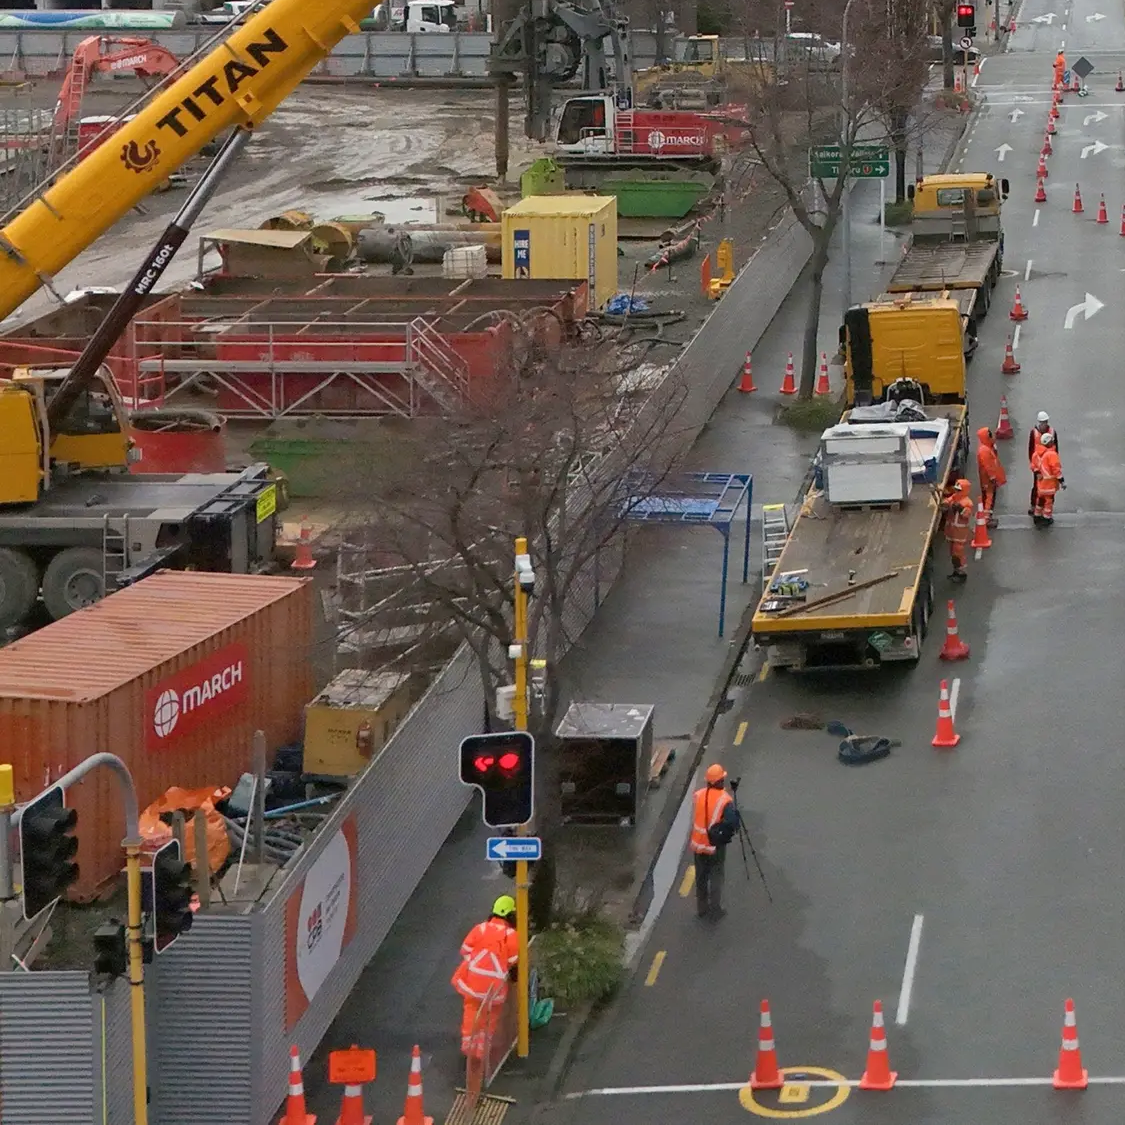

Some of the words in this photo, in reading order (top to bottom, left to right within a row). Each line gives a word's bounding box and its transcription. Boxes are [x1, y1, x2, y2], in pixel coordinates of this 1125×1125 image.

[155, 27, 289, 137] TITAN
[666, 136, 704, 145] MARCH
[831, 166, 861, 174] Tiru
[514, 240, 529, 249] HIRE
[517, 249, 527, 259] ME
[135, 269, 157, 294] MRC
[152, 244, 174, 269] 160t
[182, 660, 243, 714] MARCH
